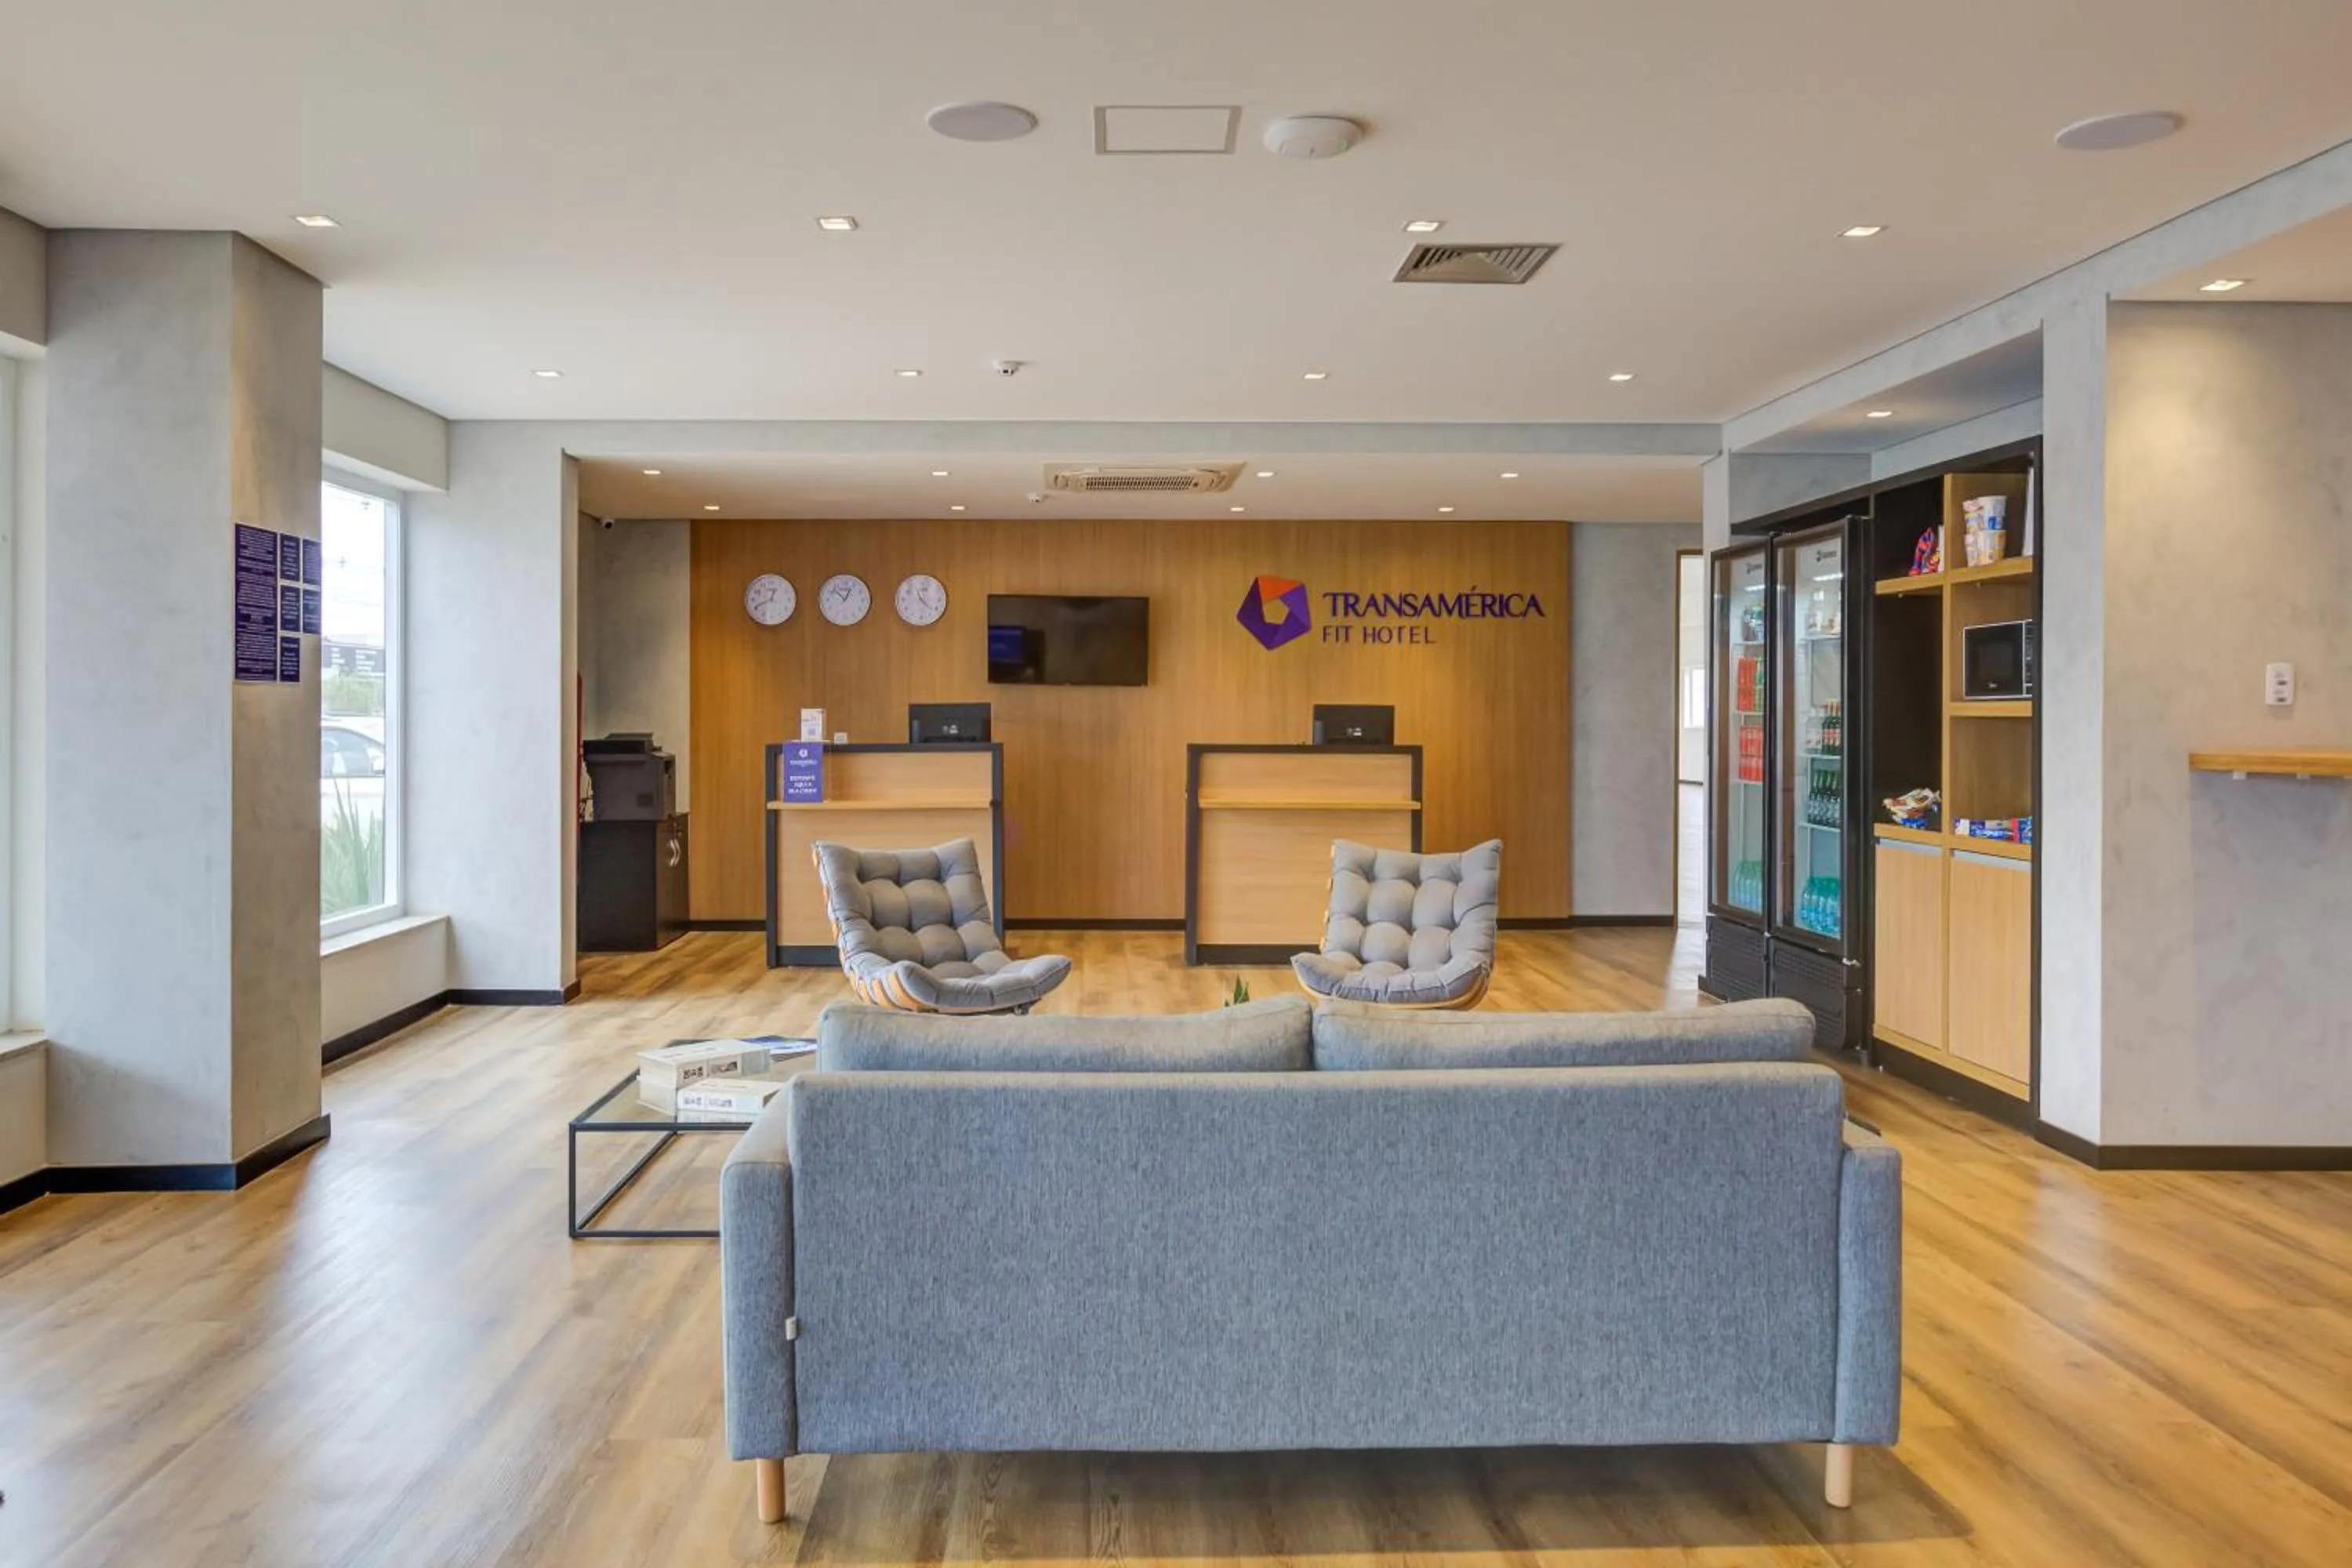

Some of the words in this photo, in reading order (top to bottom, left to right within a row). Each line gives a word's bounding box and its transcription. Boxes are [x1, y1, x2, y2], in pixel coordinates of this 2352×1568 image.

[1323, 586, 1544, 618] TRANSAMÉRICA
[1323, 626, 1353, 644] FIT
[1363, 626, 1436, 644] HOTEL
